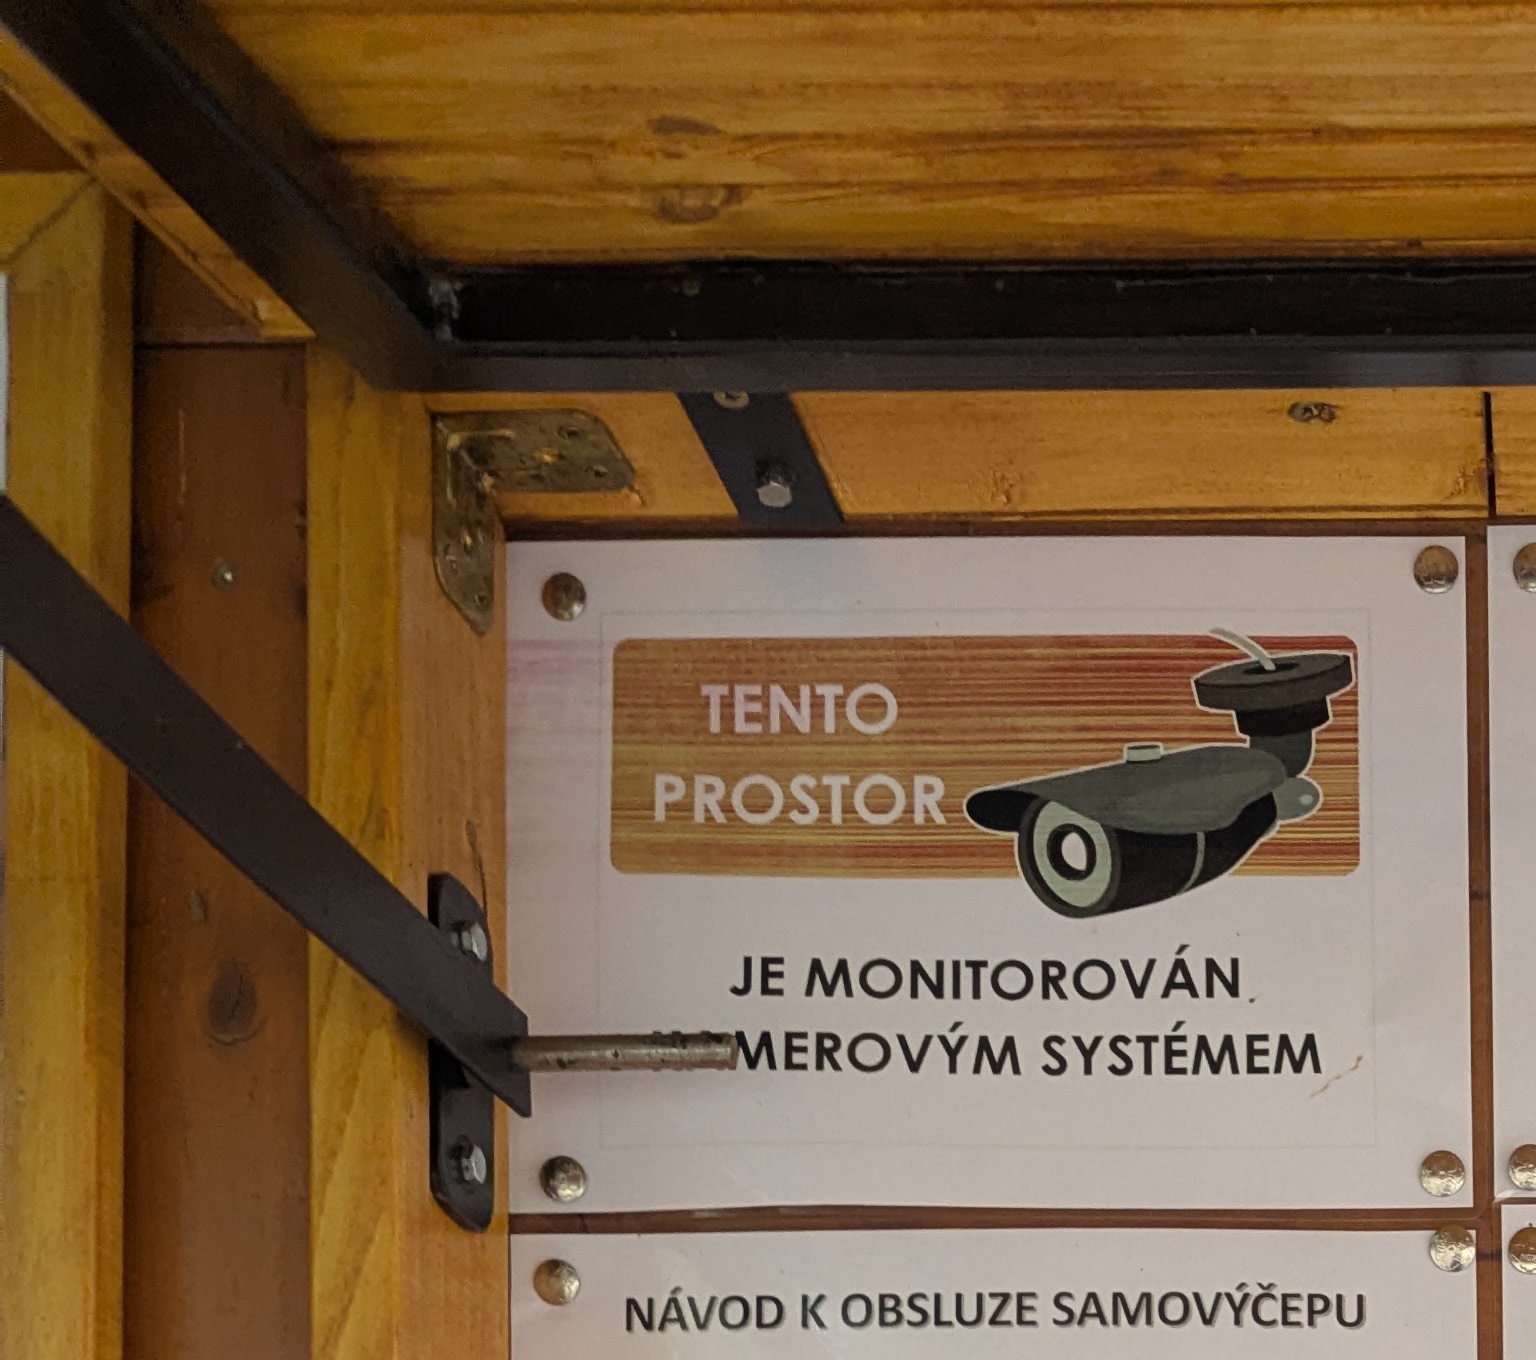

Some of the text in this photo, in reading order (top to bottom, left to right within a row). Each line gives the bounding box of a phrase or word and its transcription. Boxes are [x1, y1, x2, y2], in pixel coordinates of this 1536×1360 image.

[700, 682, 899, 736] TENTO
[653, 773, 947, 826] PROSTOR
[730, 945, 1239, 1001] JE MONITOROVÁN
[734, 1021, 1321, 1076] MEROVÝM SYSTÉMEM
[625, 1282, 1365, 1334] NÁVOD K OBSLUZE SAMOVÝČEPU
